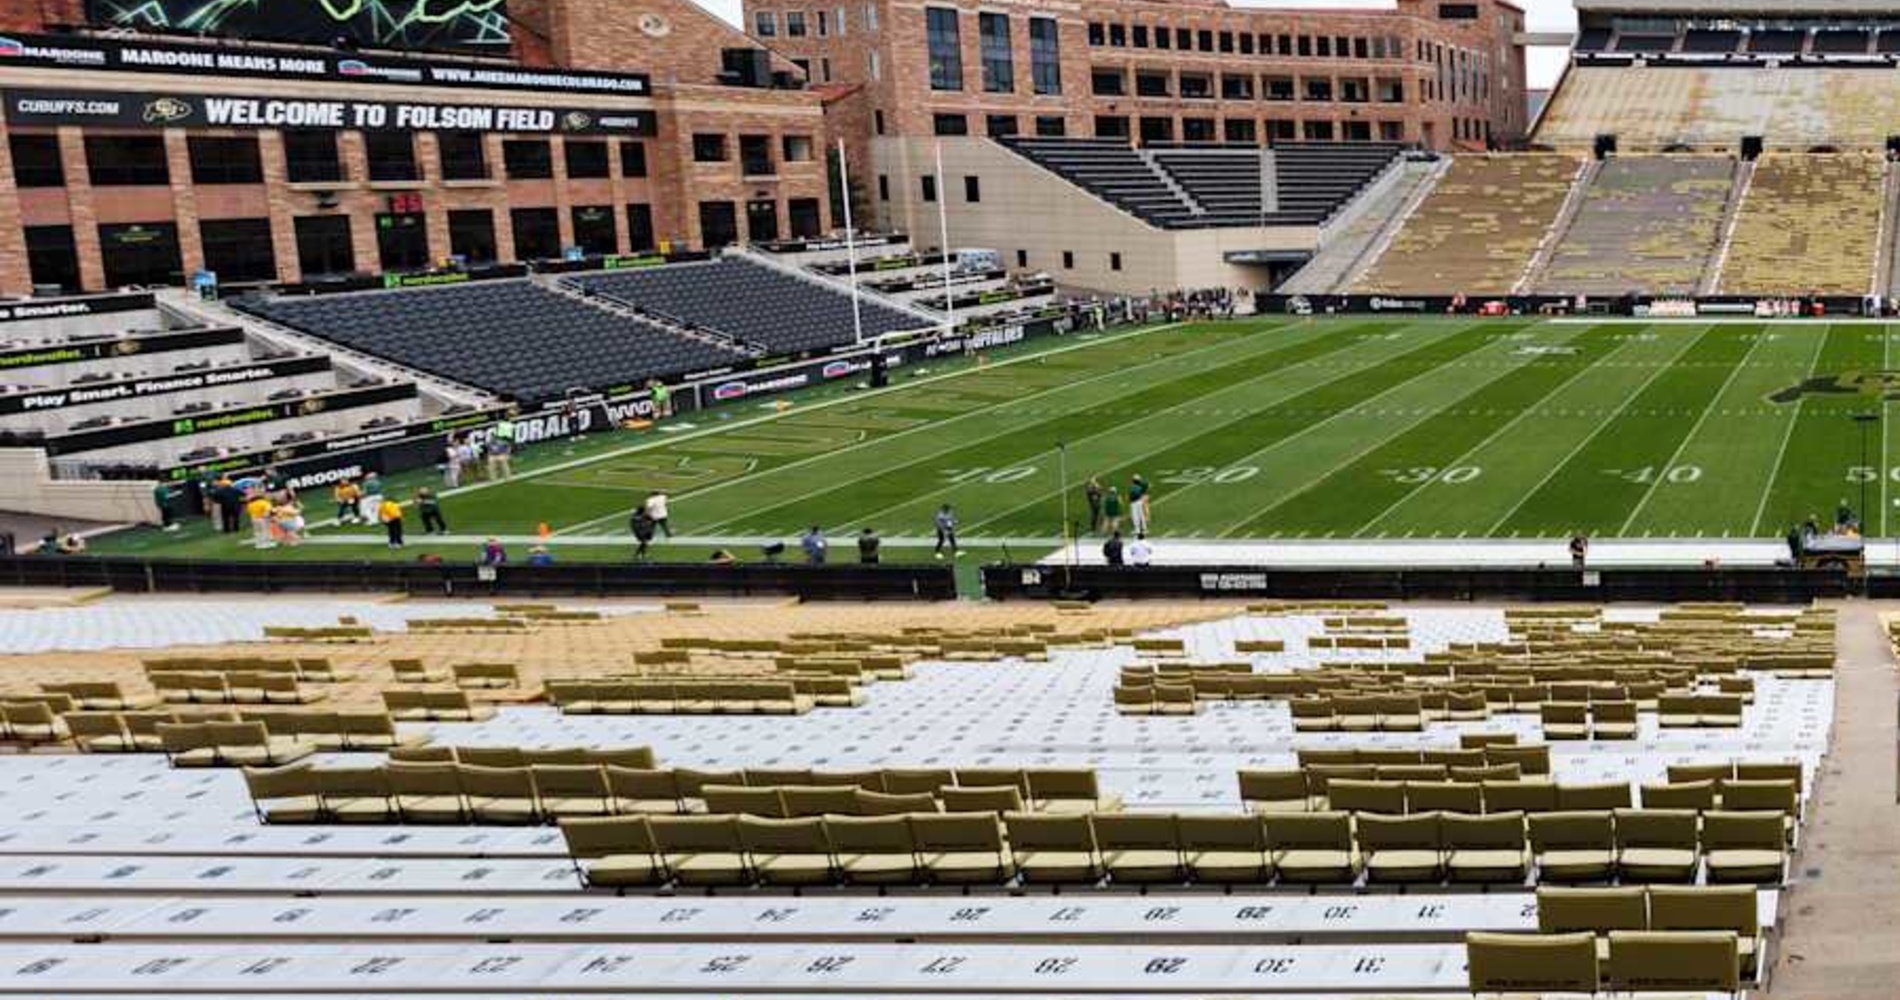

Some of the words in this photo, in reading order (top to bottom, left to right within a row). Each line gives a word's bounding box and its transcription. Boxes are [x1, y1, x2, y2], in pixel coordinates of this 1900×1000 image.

[121, 49, 214, 68] MAROONE
[217, 54, 276, 71] MEANS
[280, 57, 326, 73] MORE
[18, 99, 119, 115] CUBUFFS.COM
[205, 98, 343, 127] WELCOME
[352, 104, 386, 128] TO
[396, 105, 492, 130] FOLSOM
[496, 109, 554, 131] FIELD
[23, 394, 65, 410] Play
[70, 385, 133, 403] Smart.
[135, 376, 203, 395] Finance
[206, 367, 274, 385] Smarter.
[288, 465, 363, 490] AROONE
[1164, 465, 1260, 485] 20
[1396, 465, 1484, 485] 30
[1620, 465, 1703, 485] 40
[949, 907, 991, 922] 26
[1048, 907, 1086, 922] 27
[1234, 906, 1273, 921] 29
[1323, 905, 1359, 920] 30
[1417, 904, 1445, 919] 31
[469, 956, 523, 974] 23
[580, 956, 633, 974] 24
[699, 955, 751, 974] 25
[805, 956, 856, 974] 26
[920, 956, 967, 974] 27
[1034, 957, 1078, 974] 28
[1143, 956, 1188, 975] 29
[1253, 957, 1295, 974] 30
[1353, 957, 1386, 974] 31
